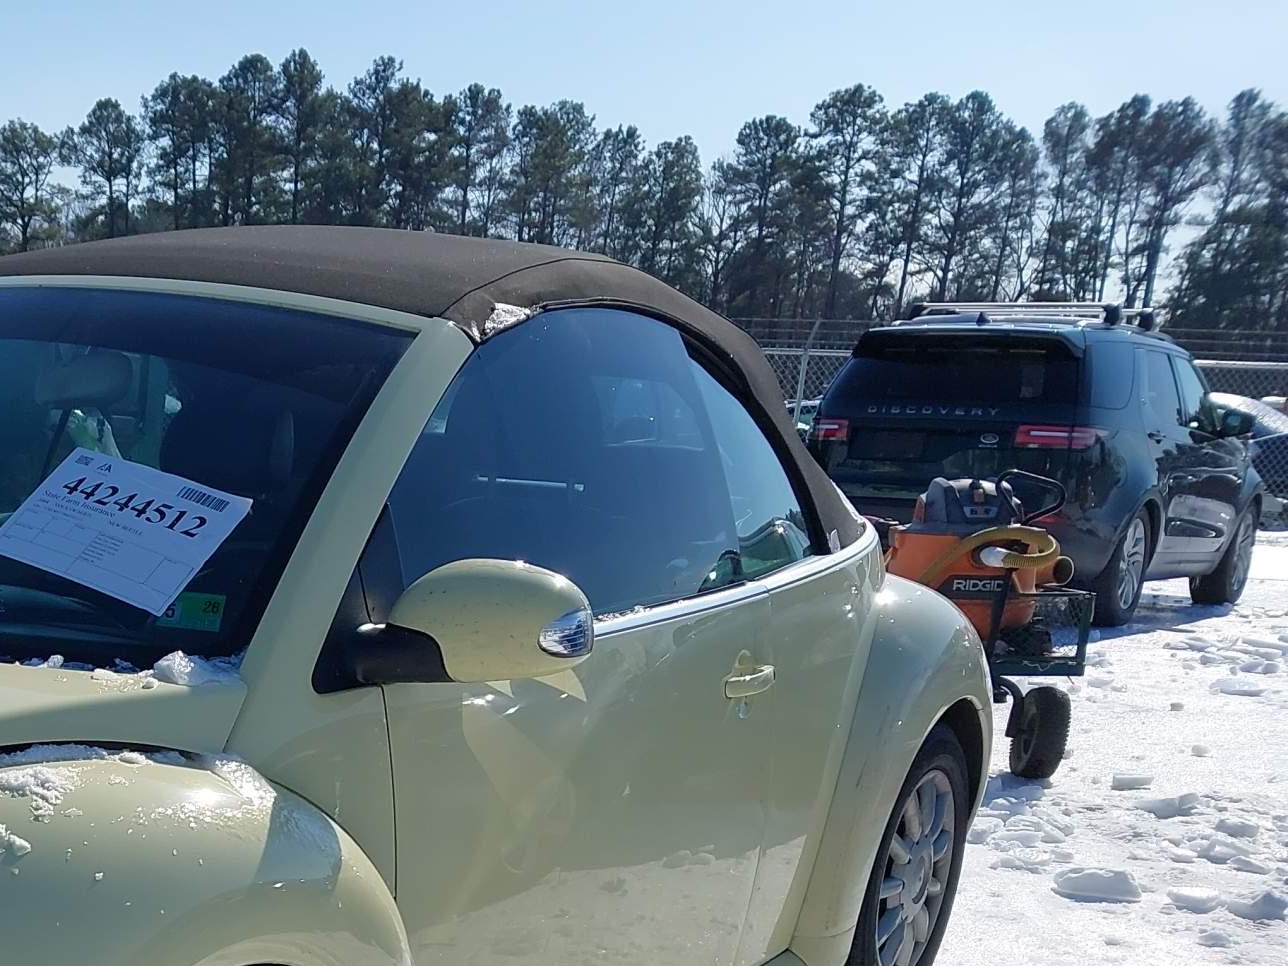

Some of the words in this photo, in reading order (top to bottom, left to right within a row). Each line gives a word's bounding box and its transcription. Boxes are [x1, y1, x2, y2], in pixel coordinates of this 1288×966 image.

[867, 405, 1000, 416] DISCOVERY
[62, 476, 208, 538] 44244512
[202, 600, 220, 614] 26
